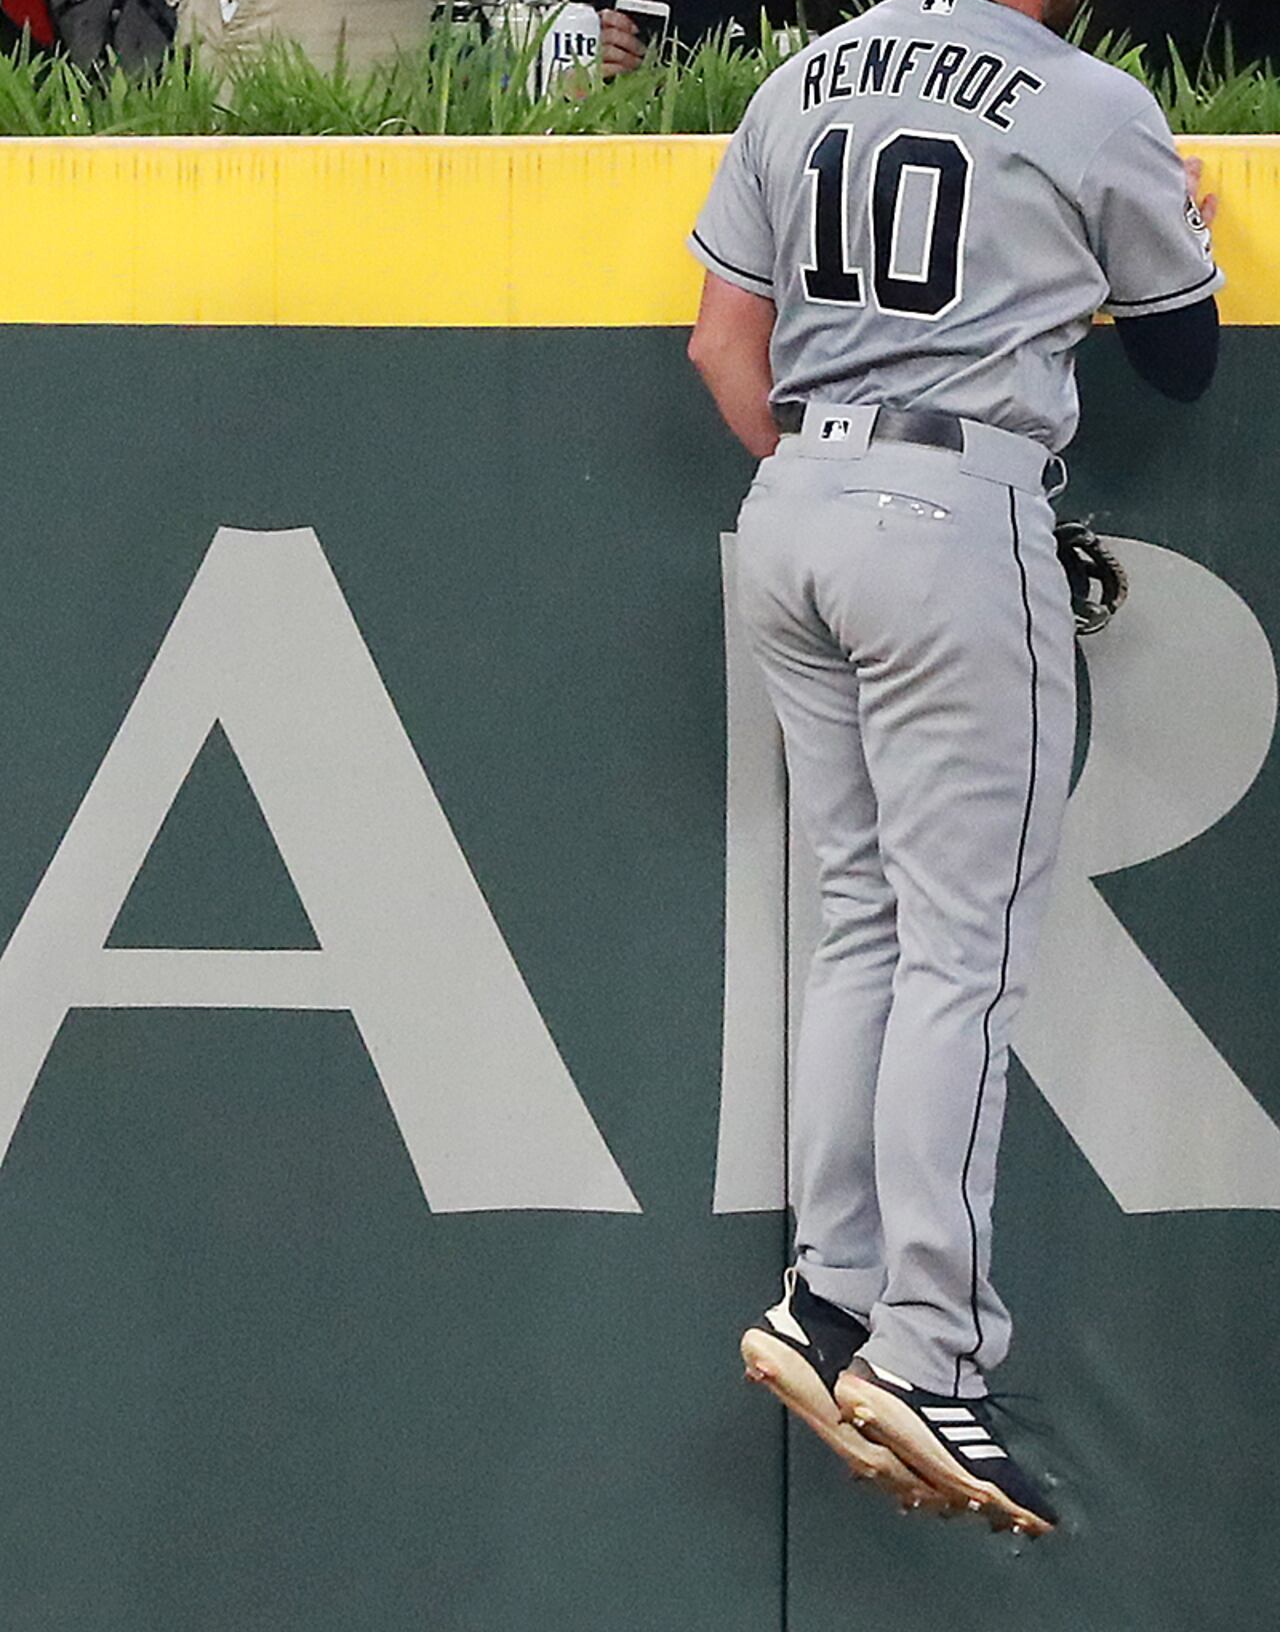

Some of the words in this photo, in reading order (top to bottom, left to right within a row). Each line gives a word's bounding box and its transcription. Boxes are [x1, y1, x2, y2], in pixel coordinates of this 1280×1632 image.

[553, 32, 598, 63] Lite
[801, 35, 1046, 133] RENFROE
[799, 122, 975, 323] 10
